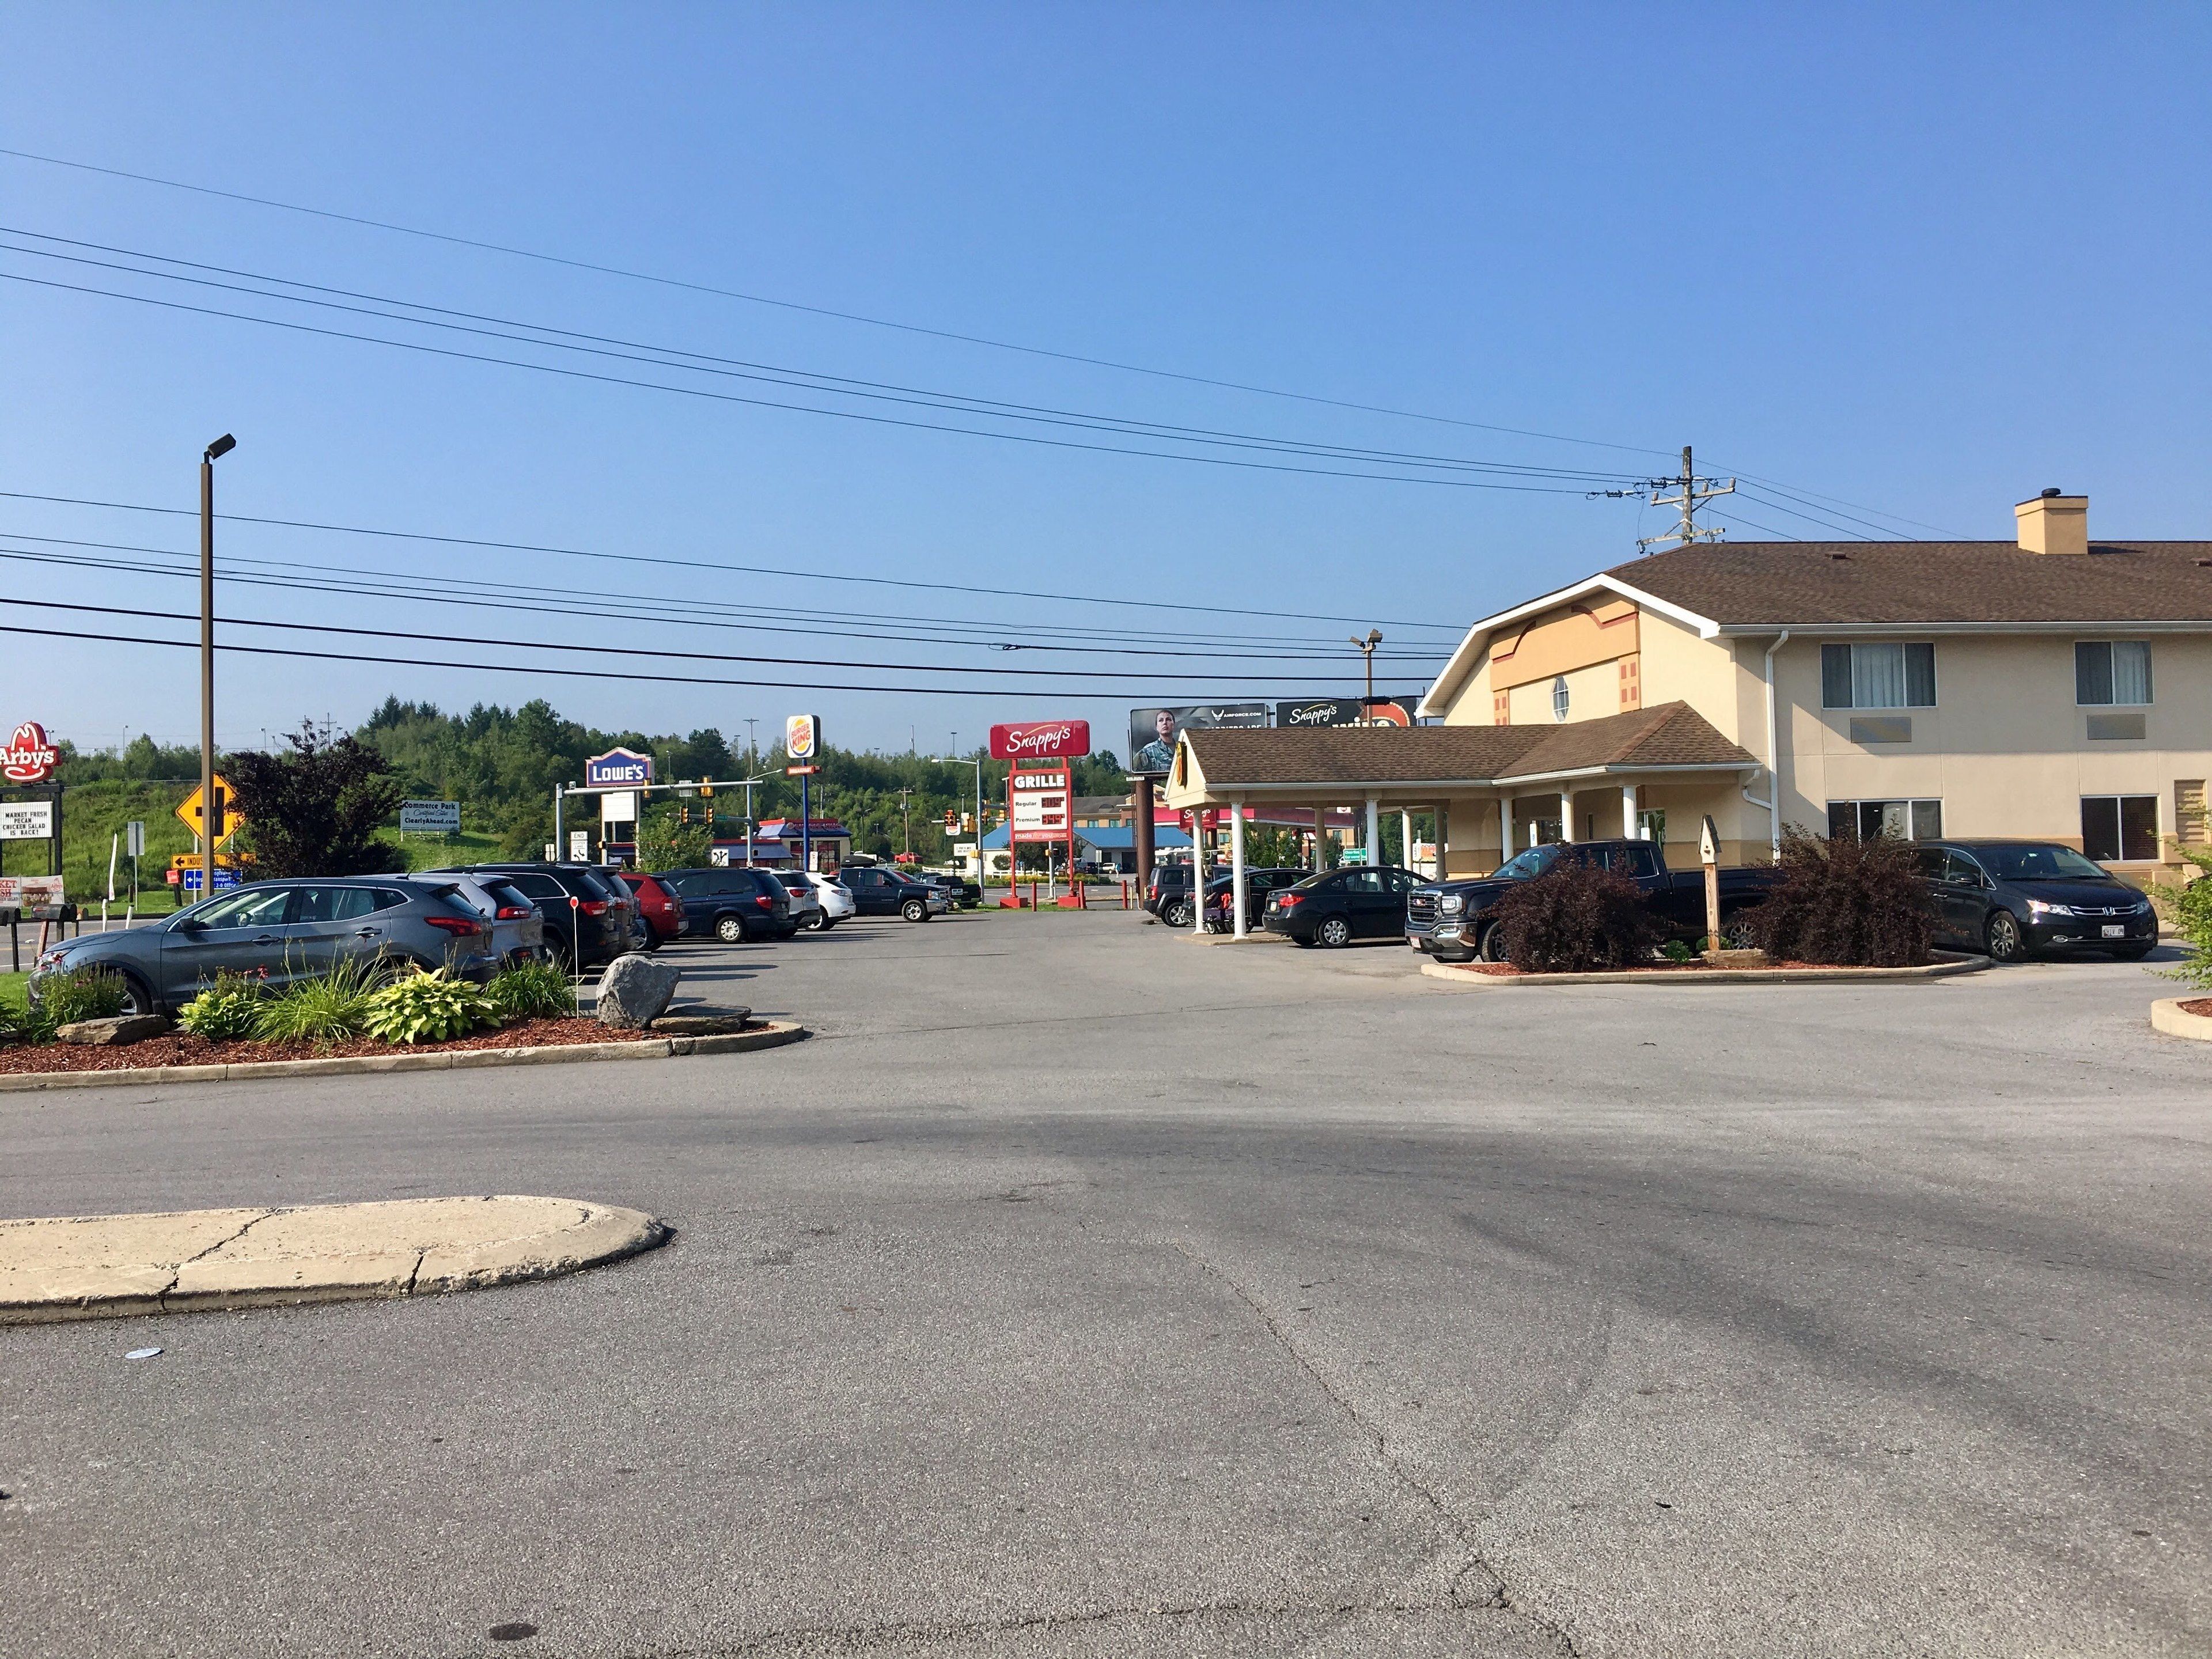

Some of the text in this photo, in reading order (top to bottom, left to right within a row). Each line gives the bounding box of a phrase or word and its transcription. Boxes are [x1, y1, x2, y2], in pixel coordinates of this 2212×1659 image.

[1289, 705, 1337, 725] Snappy's
[791, 723, 810, 739] BURGER
[792, 730, 810, 749] KING
[1006, 727, 1071, 755] Snappy's
[0, 744, 55, 769] Arby's
[593, 764, 644, 782] LOWE'S
[1014, 774, 1065, 789] GRILLE
